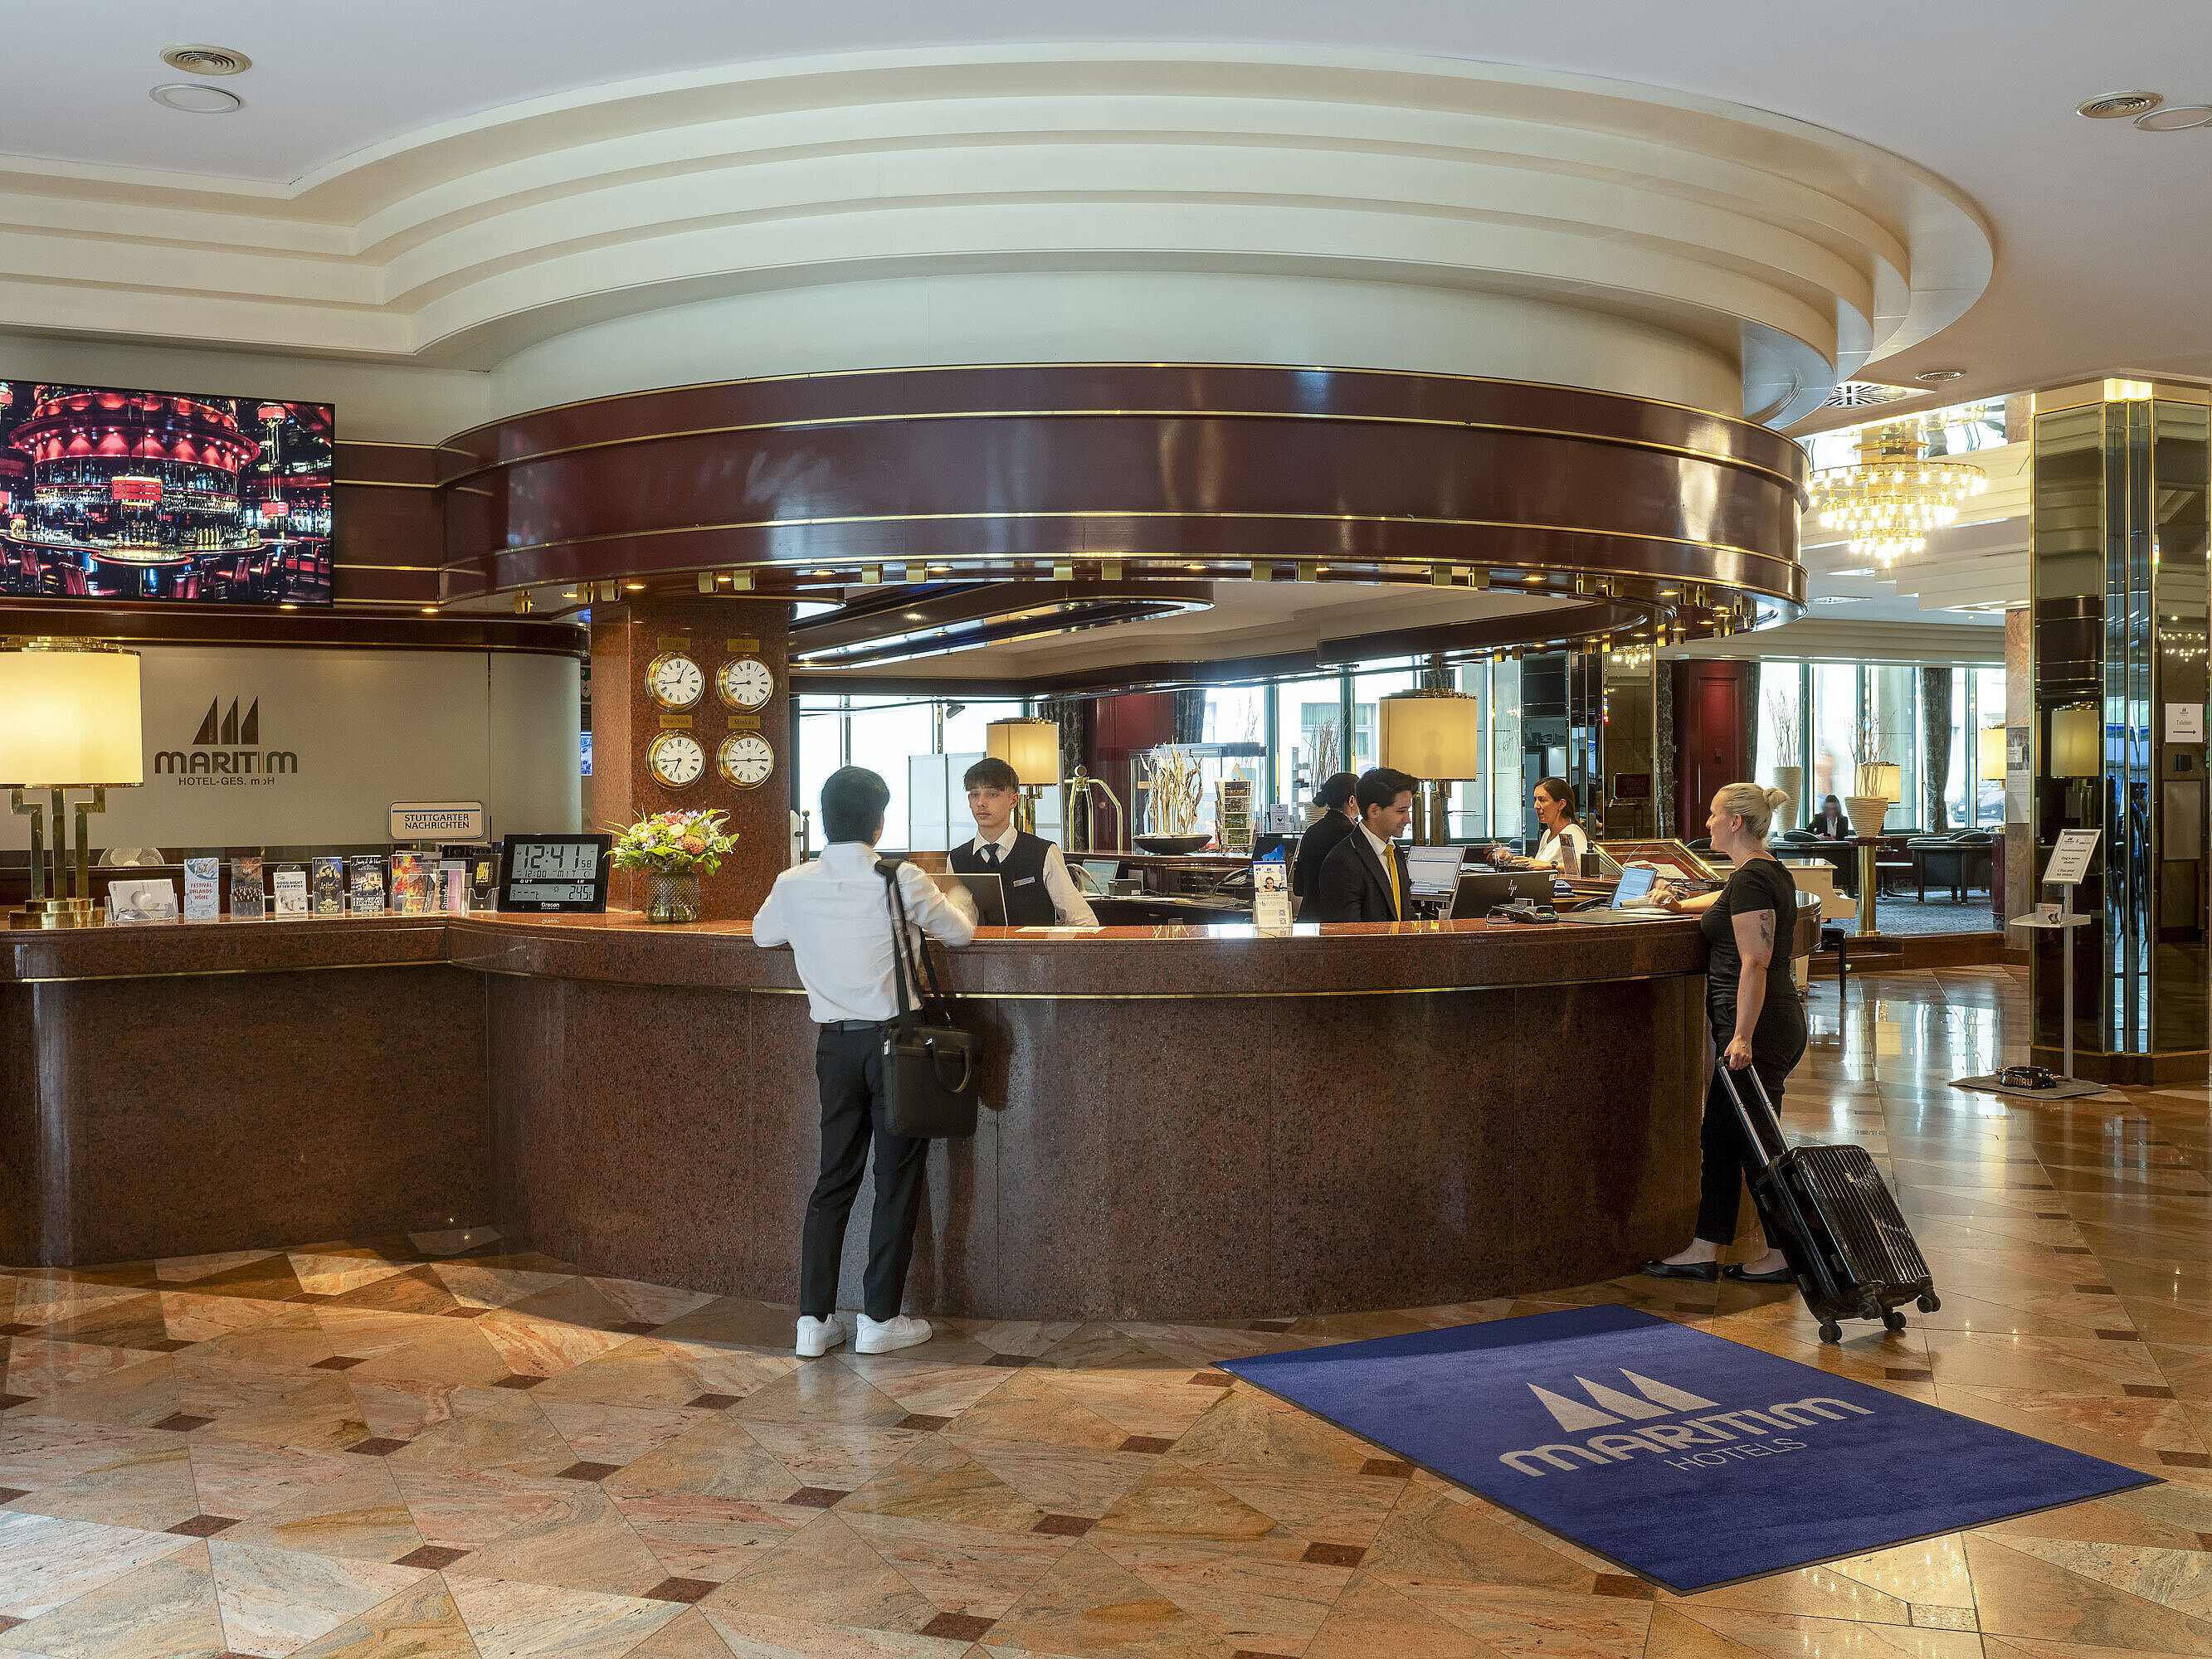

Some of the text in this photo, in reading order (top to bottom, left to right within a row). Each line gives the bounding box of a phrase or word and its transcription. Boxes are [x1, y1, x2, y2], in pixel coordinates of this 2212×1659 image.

[155, 751, 298, 774] MARITIM
[178, 776, 246, 786] HOTEL-GES.
[405, 821, 470, 830] NACHRICHTEN
[524, 845, 580, 869] 12:41
[1508, 879, 1518, 897] hp
[1498, 1397, 1875, 1477] MARITIM
[1664, 1438, 1808, 1472] HOTELS
